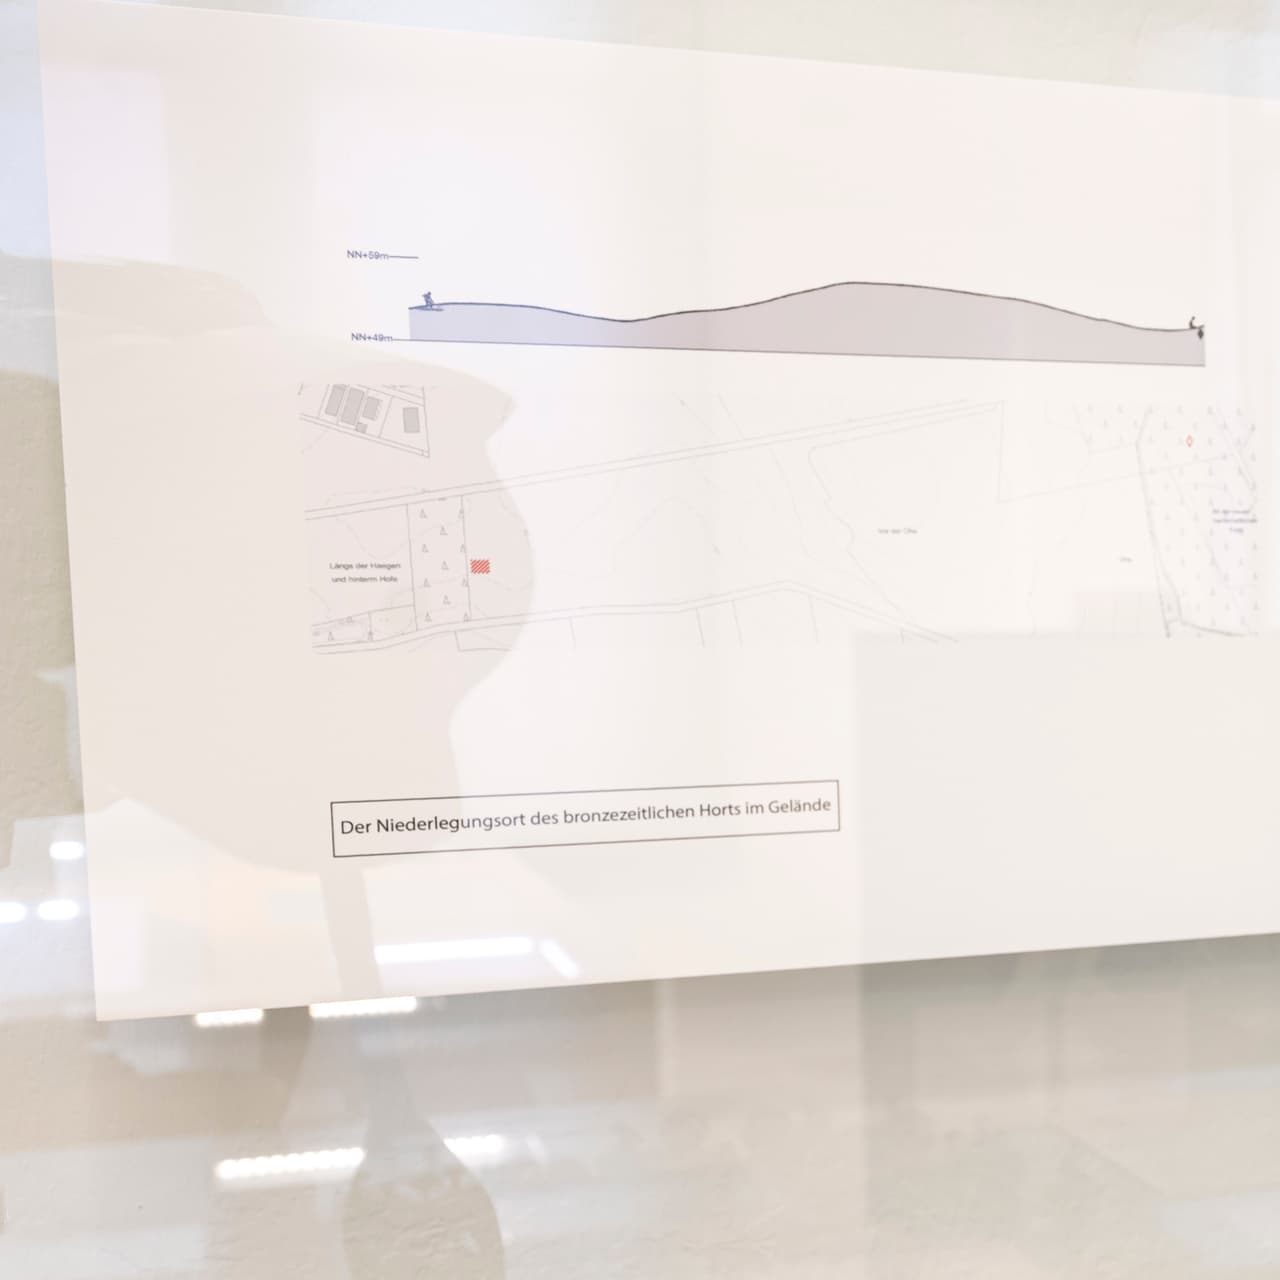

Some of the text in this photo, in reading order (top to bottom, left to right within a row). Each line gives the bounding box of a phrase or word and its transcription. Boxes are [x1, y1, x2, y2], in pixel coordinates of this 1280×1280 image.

[340, 798, 832, 835] Der Niederlegungsort des bronzezeitlichen Horts im Gelände
